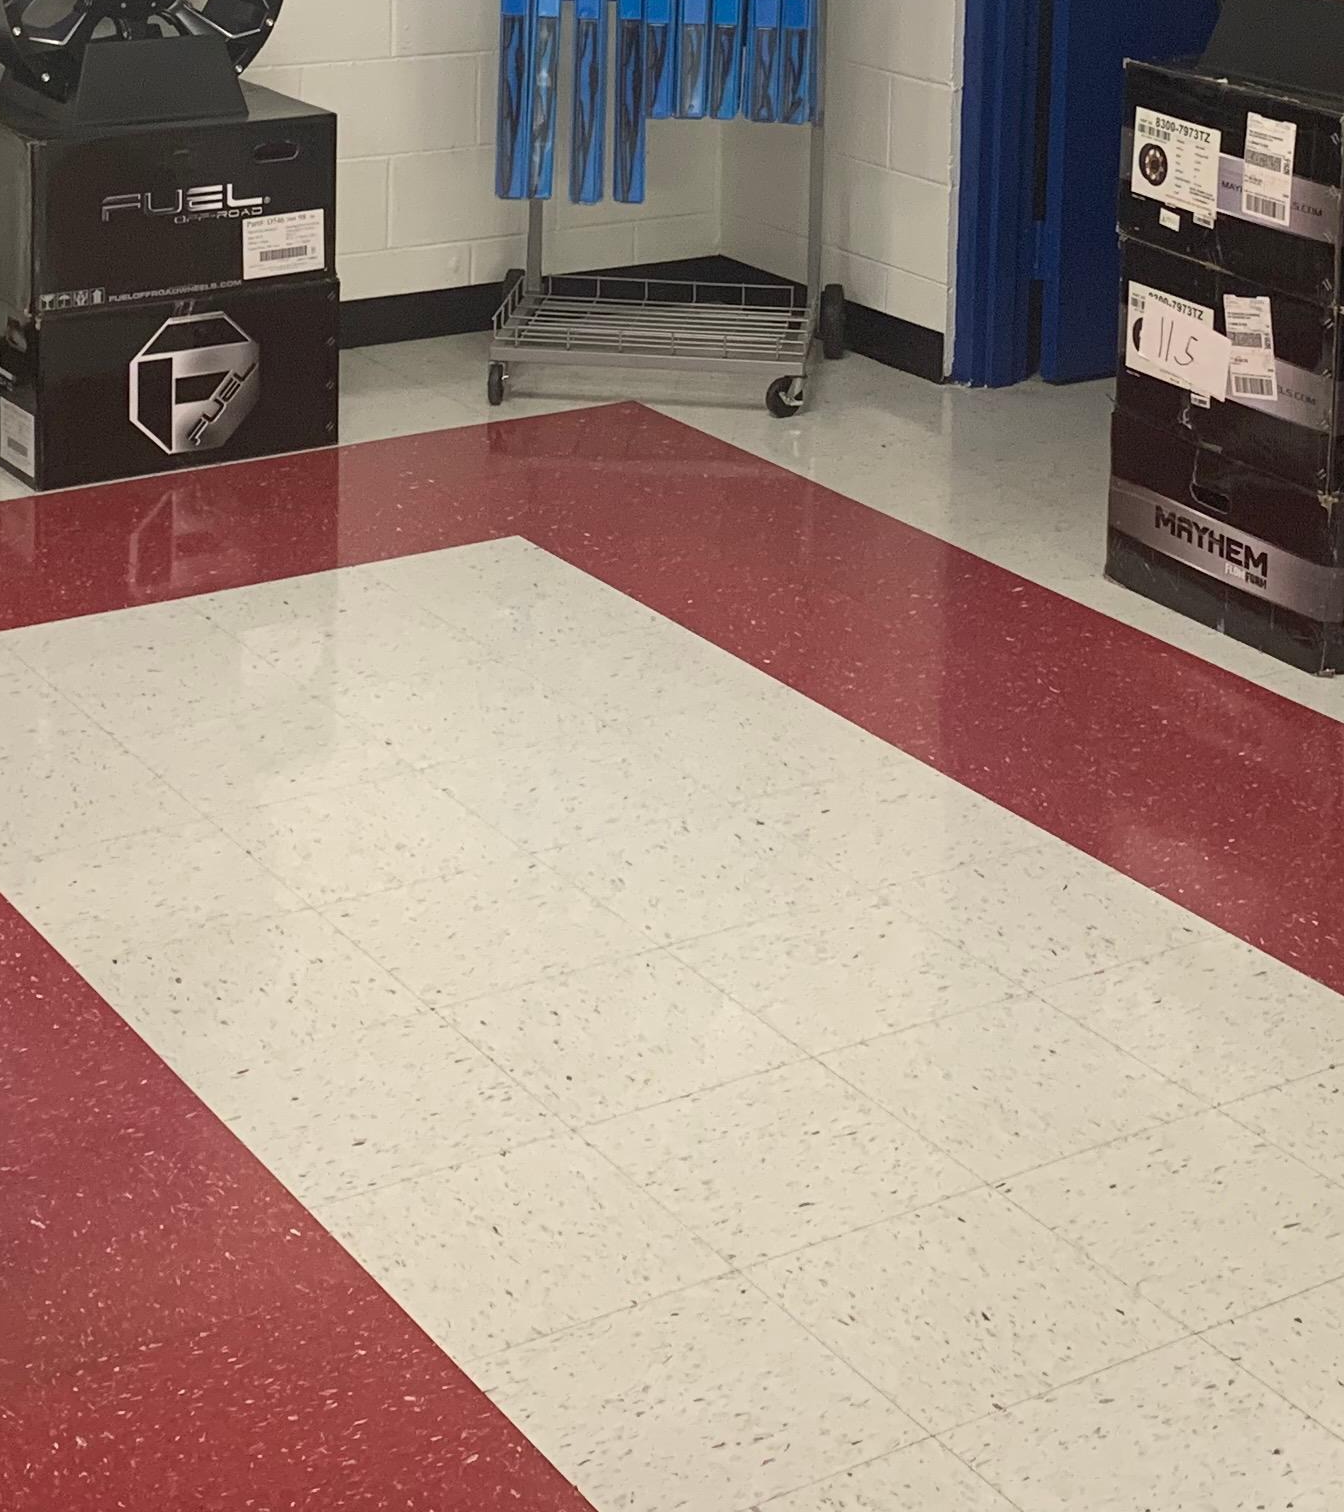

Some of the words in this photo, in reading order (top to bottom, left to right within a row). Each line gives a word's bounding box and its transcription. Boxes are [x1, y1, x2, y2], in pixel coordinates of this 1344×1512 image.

[1155, 117, 1211, 143] 8300-7973TZ
[102, 184, 263, 221] FUEL
[108, 279, 242, 302] FUELOFFROADWHEELS.COM
[1155, 504, 1268, 577] MAYHEM
